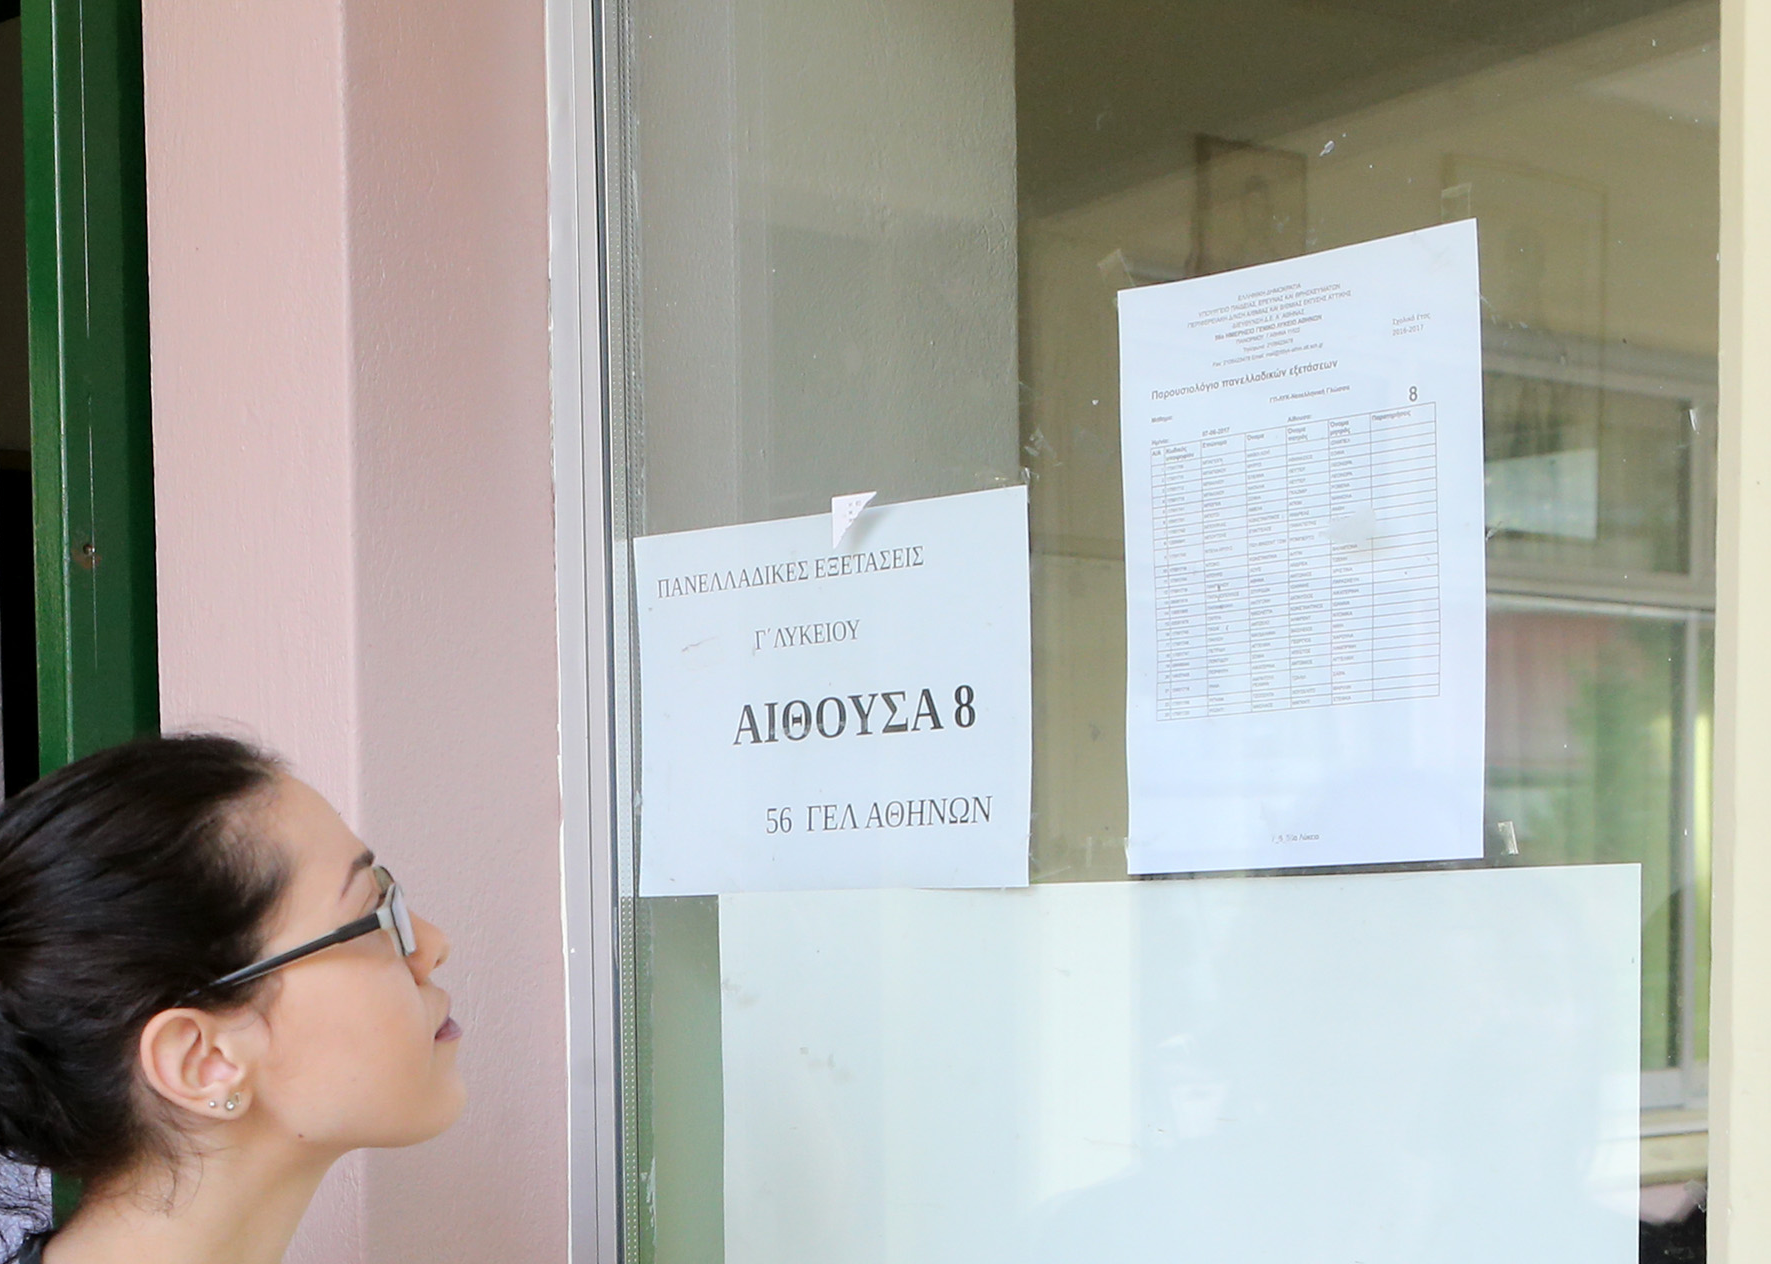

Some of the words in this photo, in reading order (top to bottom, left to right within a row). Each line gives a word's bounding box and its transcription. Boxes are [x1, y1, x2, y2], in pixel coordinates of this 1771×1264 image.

[1151, 380, 1220, 400] Παρουσιολόγιο
[1222, 367, 1287, 388] πανελλαδικών
[1288, 359, 1338, 377] εξετάσεων
[1408, 386, 1418, 401] 8
[657, 560, 808, 598] ΠΑΝΕΛΛΑΔΙΚΕΣ
[815, 546, 924, 579] ΕΞΕΤΑΣΕΙΣ
[733, 688, 944, 745] ΑΙΘΟΥΣΑ
[954, 685, 976, 728] 8
[766, 807, 792, 834] 56
[806, 804, 858, 832] ΓΕΛ
[866, 796, 993, 829] ΑΘΗΝΩΝ
